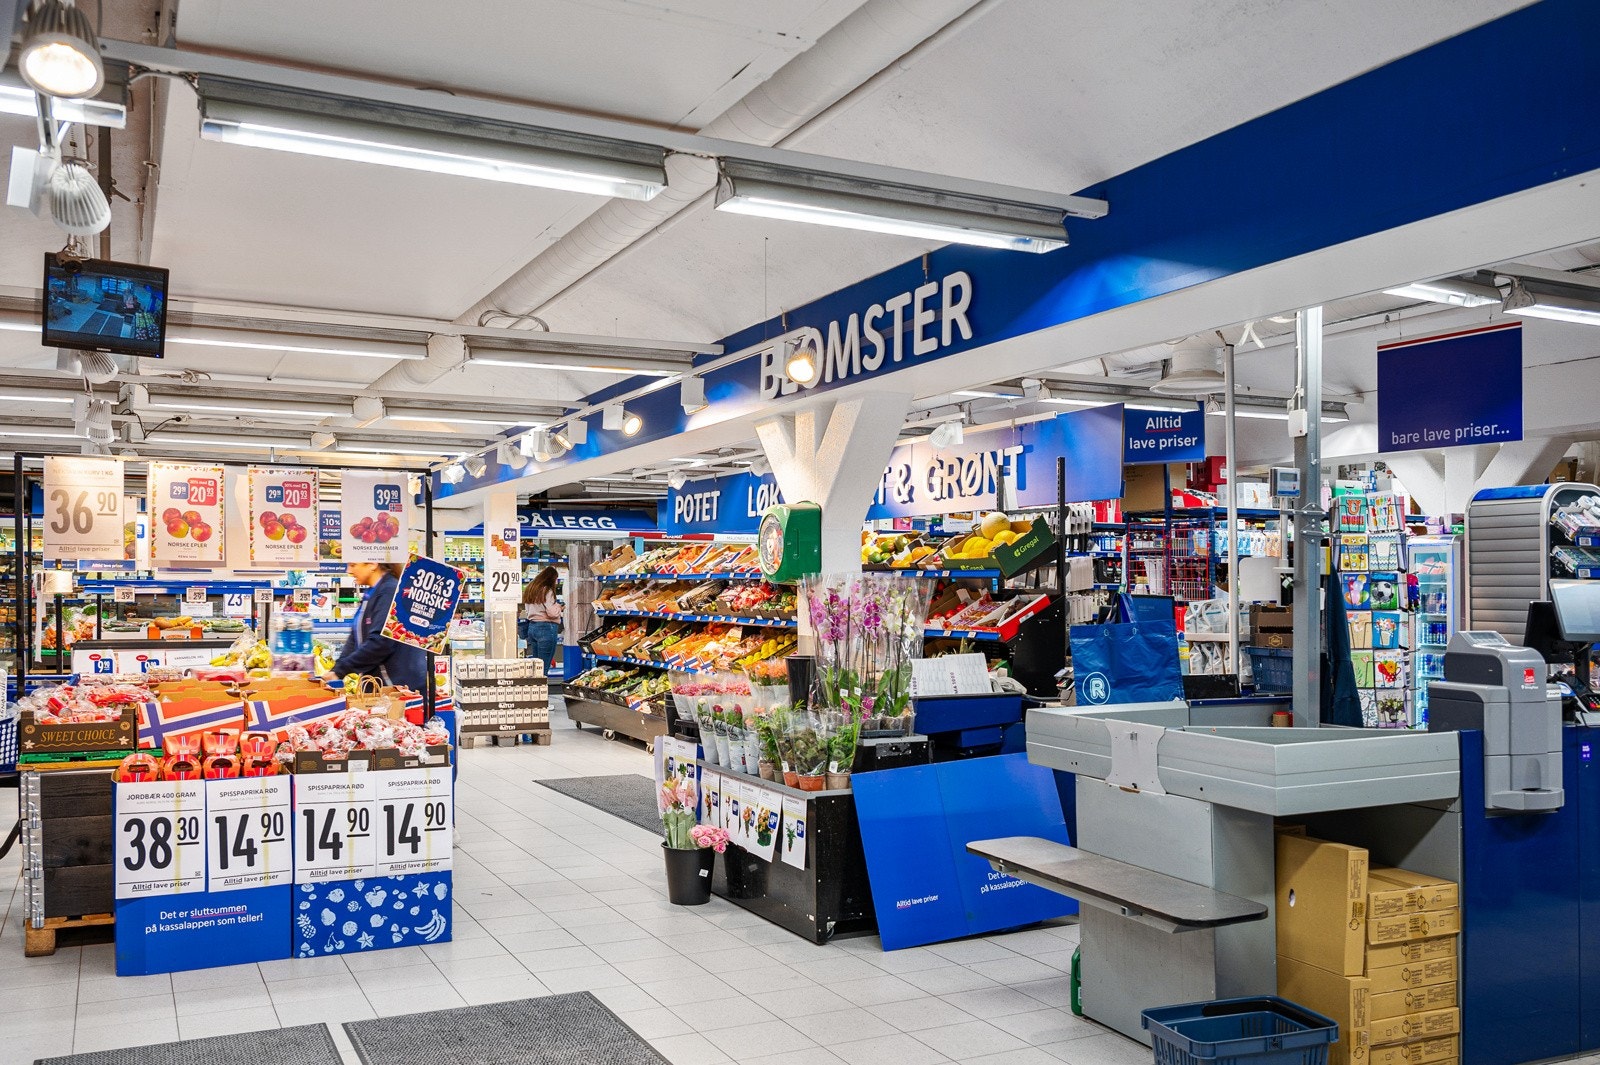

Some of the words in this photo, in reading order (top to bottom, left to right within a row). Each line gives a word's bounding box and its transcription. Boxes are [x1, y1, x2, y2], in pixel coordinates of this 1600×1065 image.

[1145, 416, 1182, 430] Alltid
[1391, 431, 1420, 445] bare
[1424, 428, 1450, 442] lave
[1455, 423, 1510, 442] priser...
[1129, 437, 1155, 449] lave
[1159, 435, 1198, 450] priser
[926, 445, 1024, 511] GRØNT
[172, 486, 181, 496] 29
[191, 485, 206, 503] 20
[206, 487, 214, 495] 93
[269, 490, 277, 499] 29
[286, 489, 300, 506] 20
[300, 490, 308, 498] 93
[377, 489, 390, 506] 39
[674, 491, 721, 523] POTET
[747, 483, 781, 518] LØK
[51, 489, 93, 534] 36
[97, 491, 117, 513] 90
[517, 512, 617, 529] PÅLEGG
[504, 531, 511, 539] 29
[1020, 536, 1040, 553] Gregal
[432, 583, 442, 595] PÅ
[443, 579, 455, 597] 3
[492, 571, 510, 592] 29
[511, 572, 519, 582] 90
[228, 594, 242, 606] 23
[408, 586, 449, 611] NORSKE
[98, 661, 104, 673] 9
[41, 731, 76, 742] SWEET
[77, 729, 115, 740] CHOICE
[126, 793, 161, 801] JORDBÆR
[219, 788, 263, 798] SPISSPAPRIKA
[303, 808, 343, 862] 14
[347, 807, 370, 832] 90
[383, 803, 421, 856] 14
[424, 802, 446, 827] 90
[123, 816, 172, 871] 38
[177, 816, 199, 841] 30
[215, 814, 258, 870] 14
[261, 811, 284, 838] 90
[309, 869, 328, 877] Alltid
[343, 867, 363, 875] priser
[389, 863, 407, 871] Alltid
[421, 861, 440, 869] priser
[223, 877, 243, 885] Alltid
[262, 873, 279, 882] priser
[988, 872, 1000, 881] Det
[132, 883, 152, 891] Alltid
[169, 880, 191, 889] priser
[980, 884, 989, 894] på
[896, 899, 911, 908] Alltid
[911, 897, 923, 905] lave
[923, 895, 939, 904] priser
[160, 911, 177, 920] Det
[178, 910, 189, 918] er
[190, 904, 248, 917] sluttsummen
[145, 924, 158, 934] på
[159, 919, 215, 932] kassalappen
[217, 917, 236, 926] som
[237, 912, 263, 923] teller!
